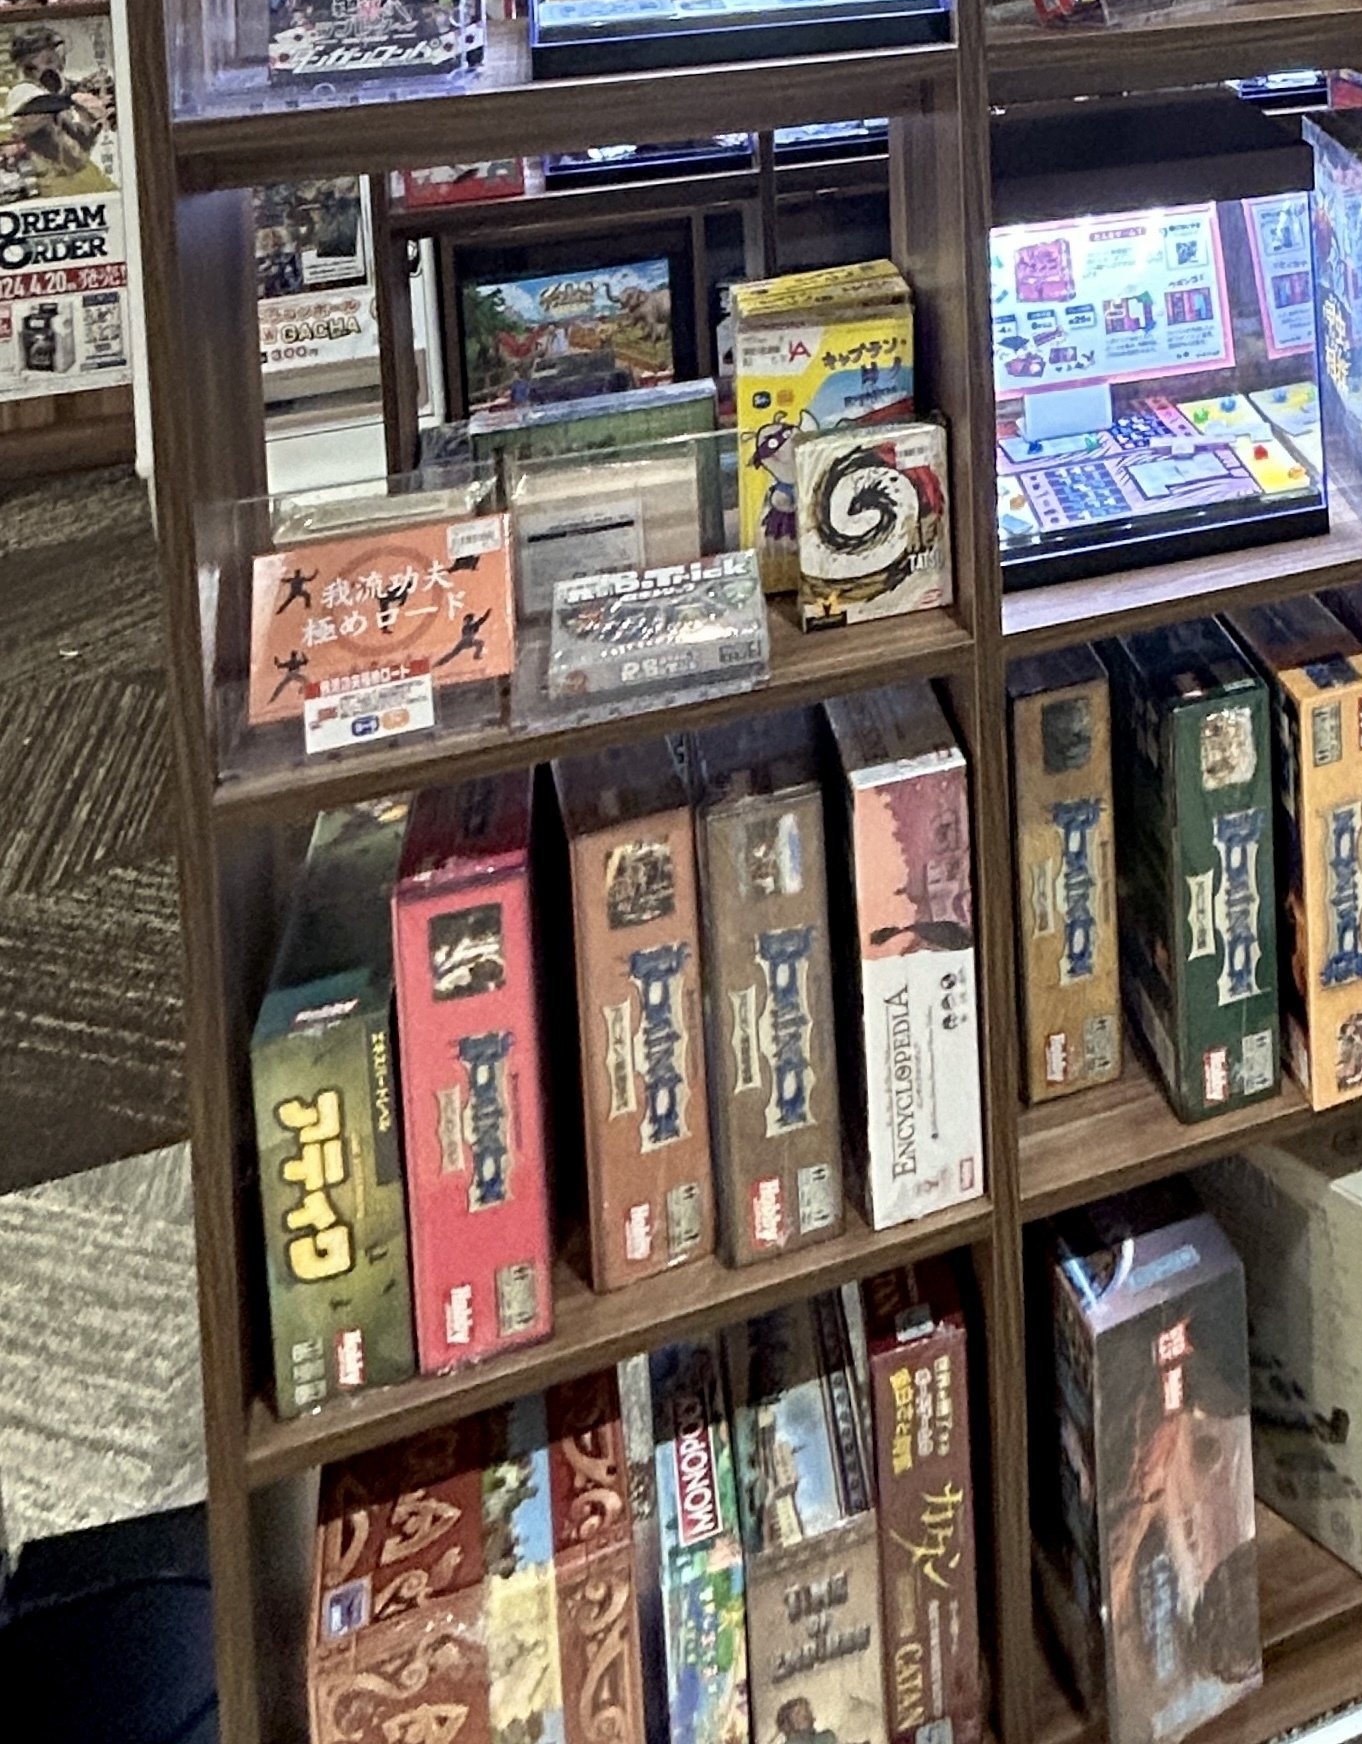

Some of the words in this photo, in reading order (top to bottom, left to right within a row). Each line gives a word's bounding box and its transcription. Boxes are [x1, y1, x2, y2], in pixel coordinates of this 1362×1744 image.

[0, 204, 107, 240] DREAM
[0, 236, 109, 270] ORDER
[0, 270, 67, 300] 24.4.20
[280, 316, 361, 344] GACHA
[320, 558, 454, 608] 我流功夫
[301, 589, 466, 648] 極めロード
[889, 984, 917, 1180] ENCYCLOPEDIA
[889, 1480, 964, 1589] カタン
[894, 1638, 925, 1729] CATAN
